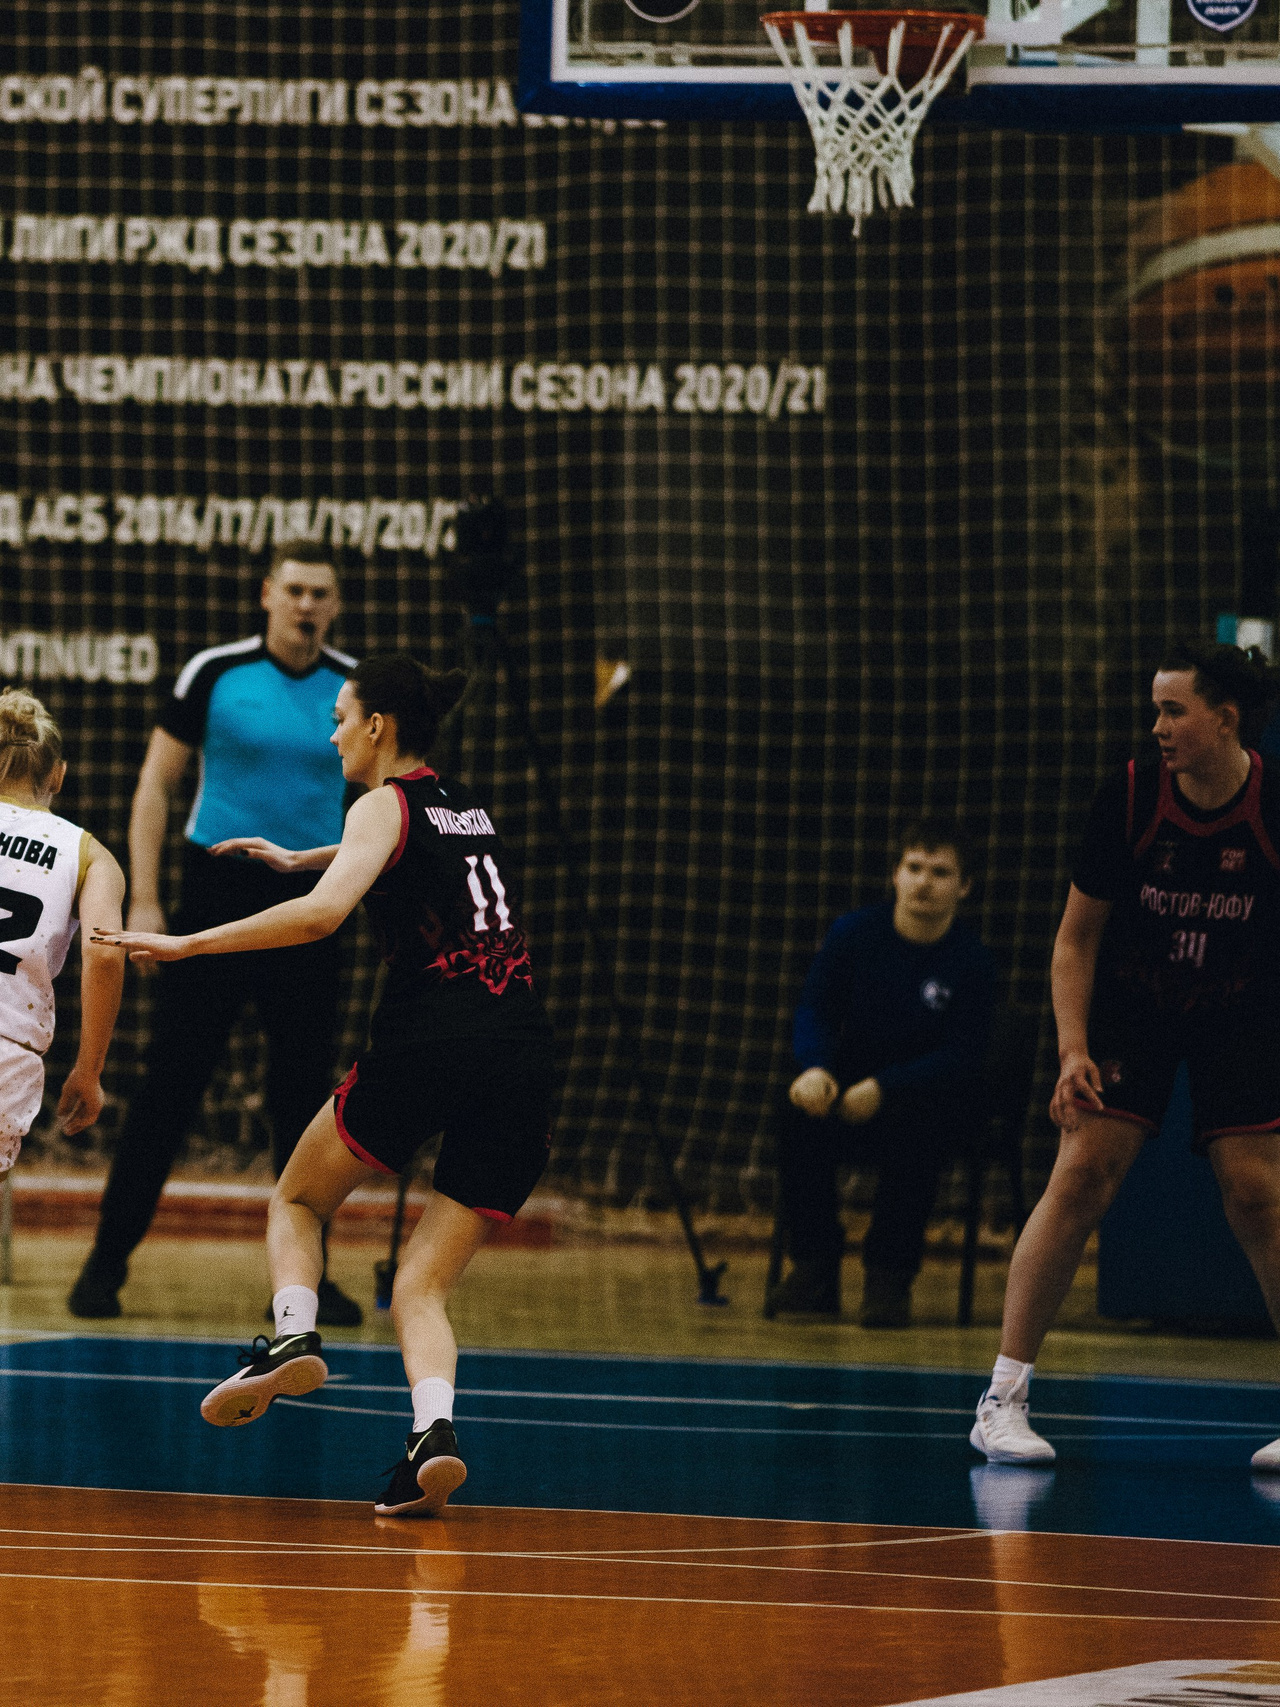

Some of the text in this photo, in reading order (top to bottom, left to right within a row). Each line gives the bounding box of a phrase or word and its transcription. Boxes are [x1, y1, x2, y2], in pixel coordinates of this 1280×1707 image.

[111, 75, 349, 126] СУПЕРЛИГИ
[355, 79, 519, 128] СЕЗОНА
[9, 213, 118, 262] ЛИГИ
[123, 217, 224, 274] РЖД
[228, 218, 390, 268] СЕЗОНА
[395, 219, 547, 276] 2020/21
[61, 355, 337, 406] ЧЕМПИОНАТА
[339, 360, 504, 410] РОССИИ
[510, 362, 667, 412] СЕЗОНА
[673, 360, 827, 420] 2020/21
[26, 495, 109, 544] АСБ
[465, 855, 514, 931] 11
[1141, 884, 1254, 920] РОСТОВ-ЮФУ
